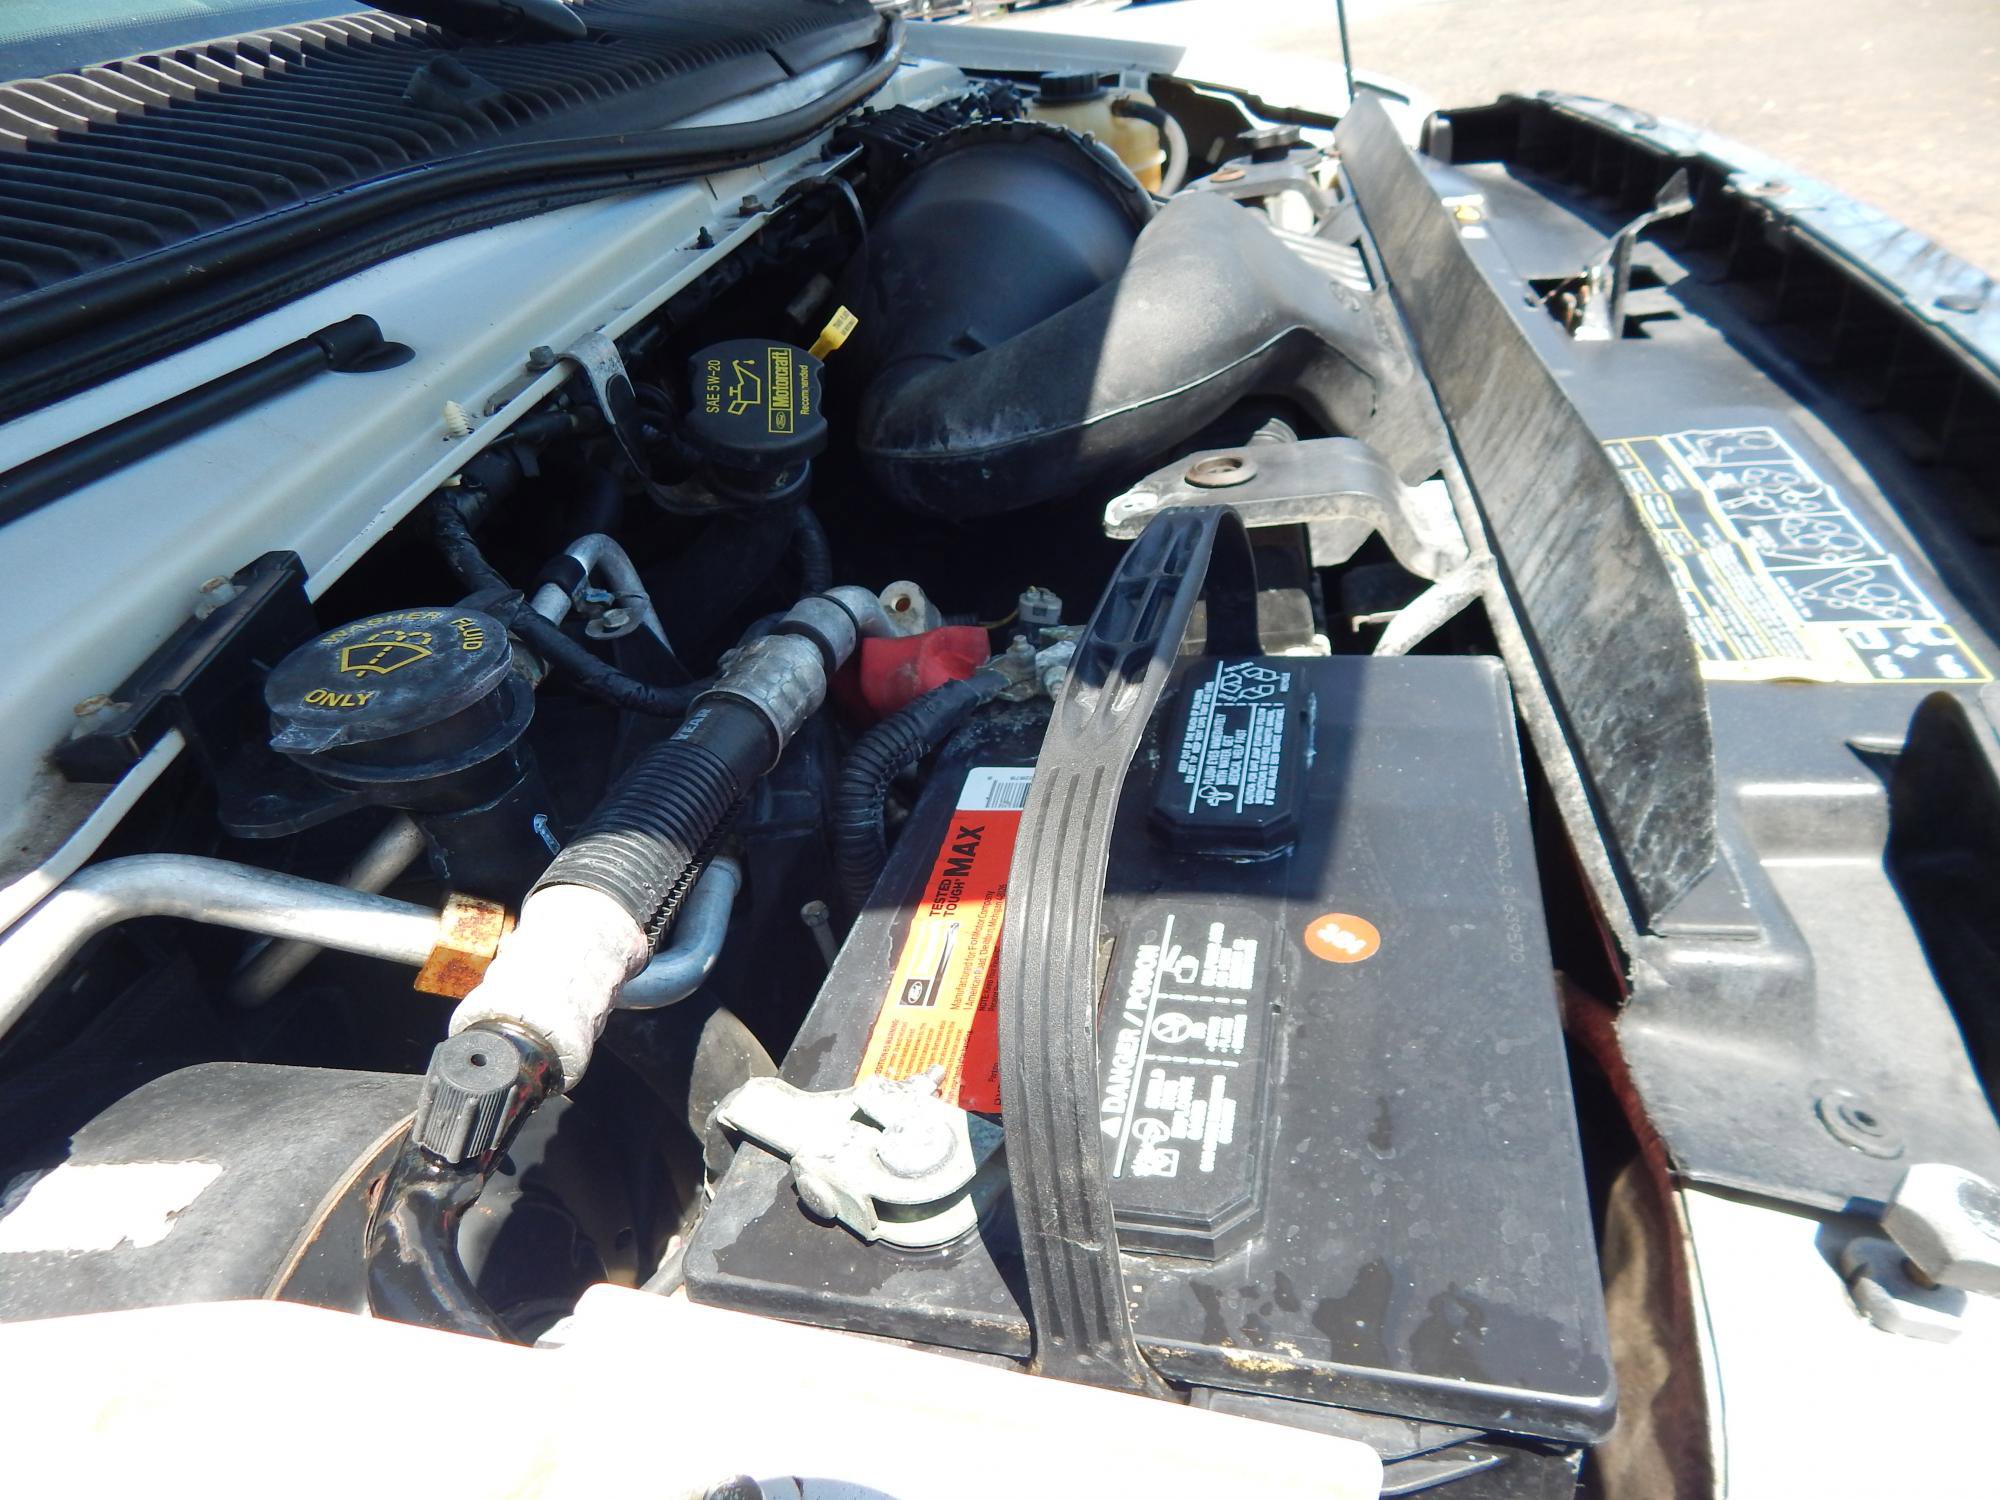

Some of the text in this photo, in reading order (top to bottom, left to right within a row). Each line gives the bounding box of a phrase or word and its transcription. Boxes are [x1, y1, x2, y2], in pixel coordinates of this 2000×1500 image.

[706, 360, 720, 413] SAE 5W-20
[772, 350, 789, 407] Motorcraft
[320, 611, 485, 651] WASHER FLUID
[304, 688, 374, 707] ONLY
[669, 708, 713, 741] YEAR
[943, 826, 985, 877] MAX
[929, 879, 951, 916] TESTED
[1101, 944, 1160, 1113] DANGER / POISON
